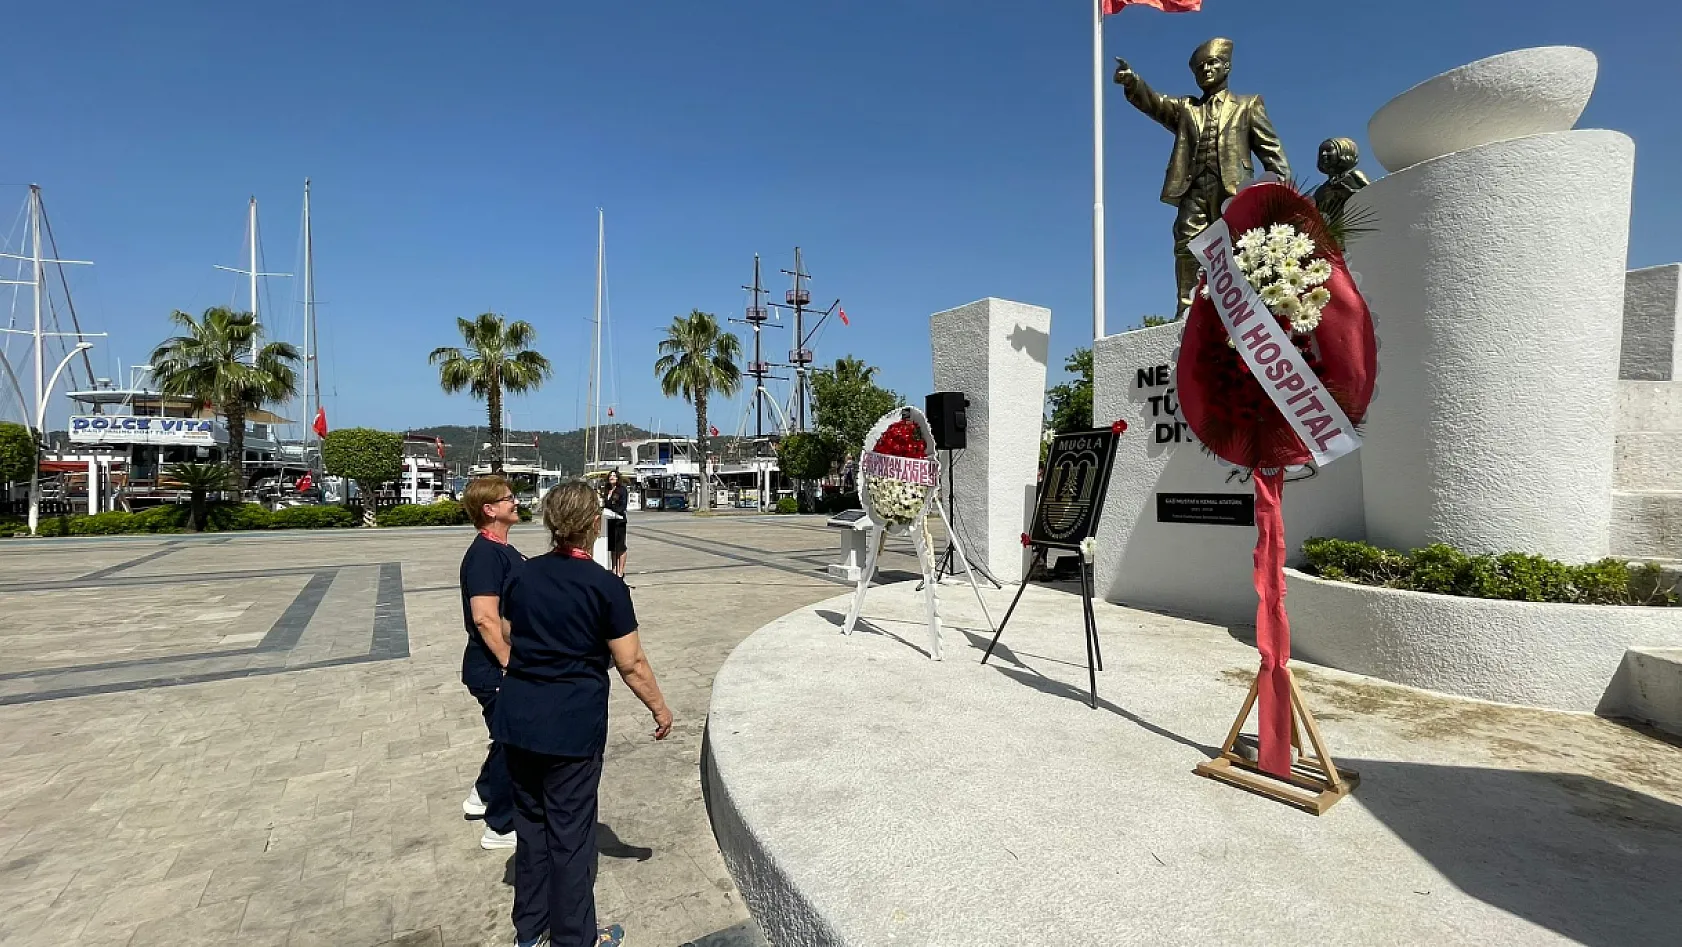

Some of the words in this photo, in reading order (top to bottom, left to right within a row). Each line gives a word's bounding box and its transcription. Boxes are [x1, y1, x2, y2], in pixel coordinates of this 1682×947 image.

[1203, 235, 1255, 328] LETOON
[1241, 322, 1342, 452] HOSPİTAL
[1138, 365, 1170, 388] NE
[73, 417, 150, 430] DOLCE
[160, 420, 213, 431] VITA
[1058, 436, 1102, 451] MUĞLA
